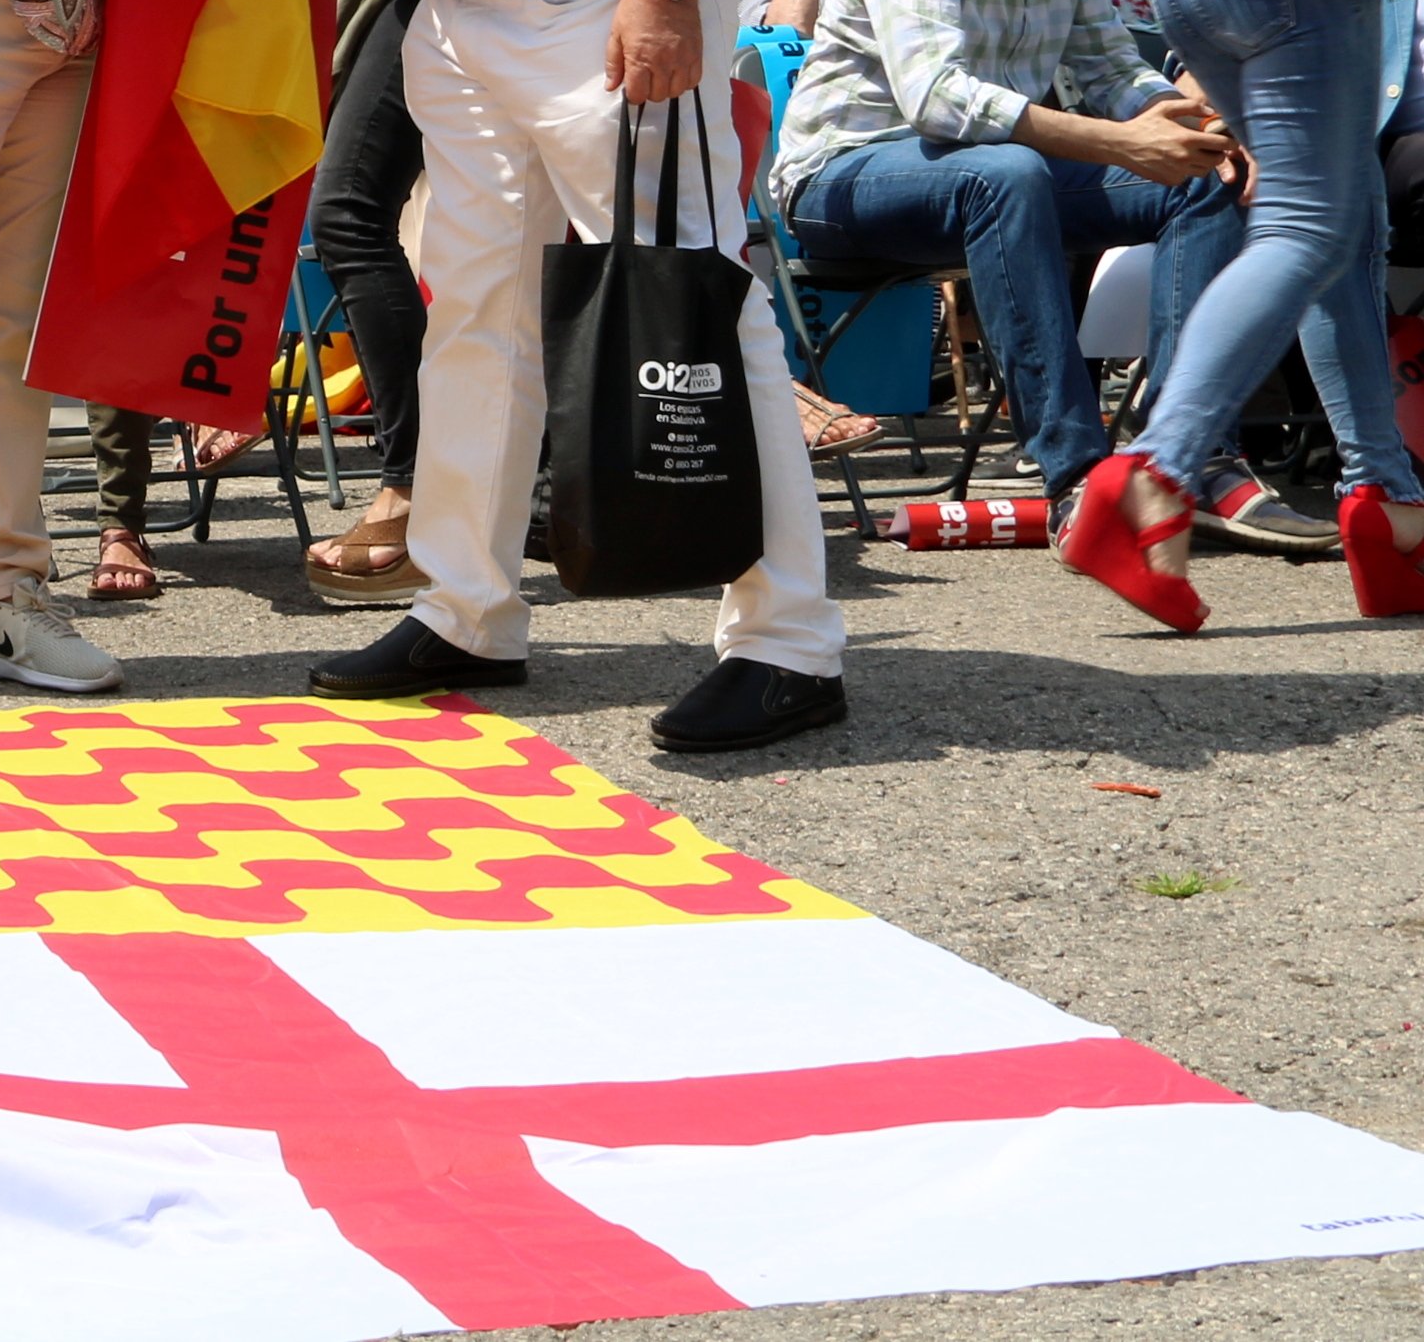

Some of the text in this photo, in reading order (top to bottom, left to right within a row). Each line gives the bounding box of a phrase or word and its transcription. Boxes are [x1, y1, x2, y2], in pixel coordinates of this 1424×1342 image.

[179, 295, 248, 398] Por
[638, 360, 690, 394] Oi2
[656, 414, 669, 423] en
[659, 401, 676, 413] Los
